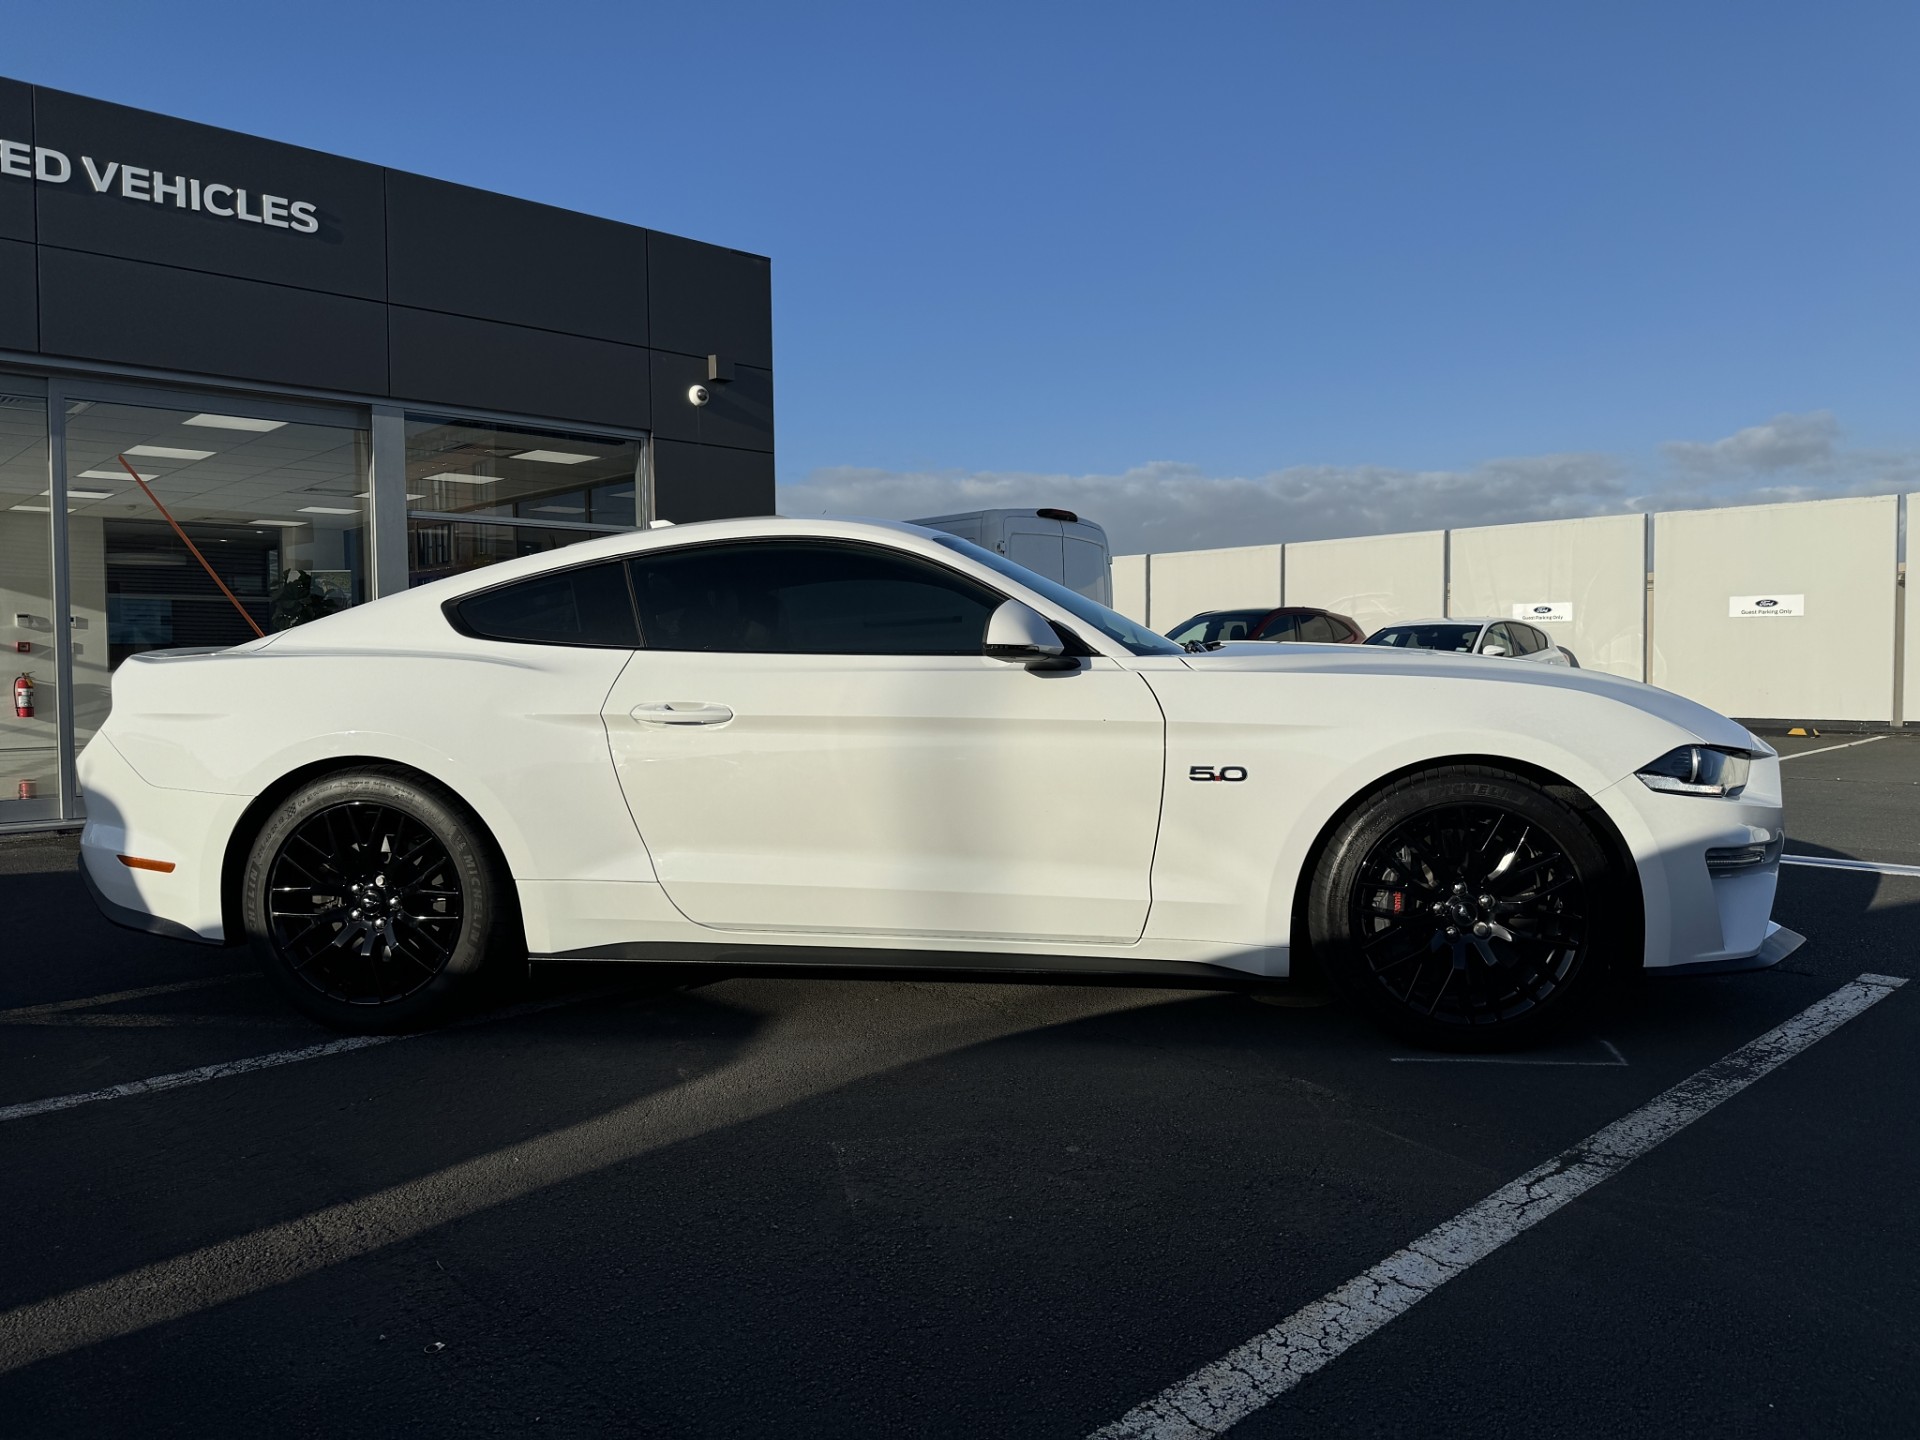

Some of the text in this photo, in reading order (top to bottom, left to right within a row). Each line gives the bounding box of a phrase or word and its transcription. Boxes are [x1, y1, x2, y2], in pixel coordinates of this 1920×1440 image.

[0, 139, 319, 234] ED VEHICLES
[1189, 766, 1248, 782] 5.0
[463, 854, 483, 943] MICHELIN
